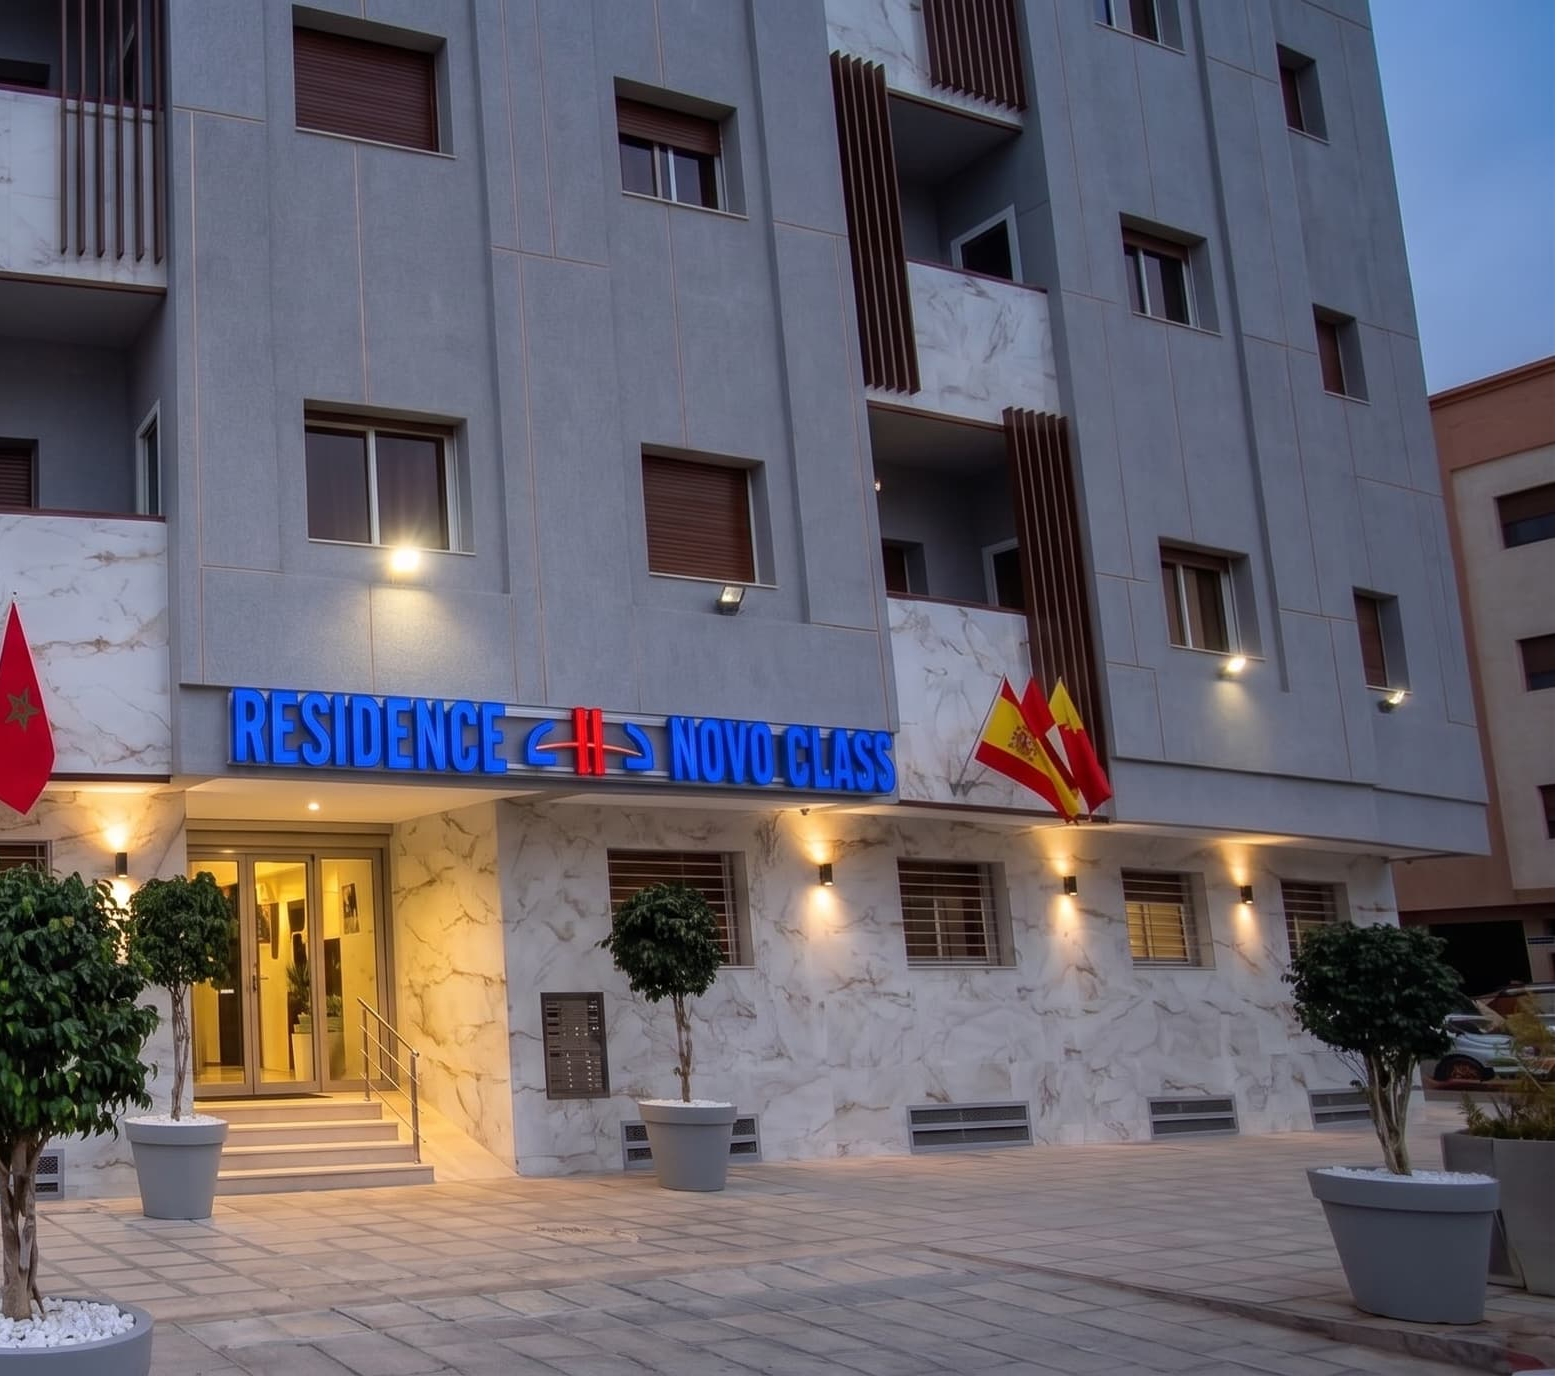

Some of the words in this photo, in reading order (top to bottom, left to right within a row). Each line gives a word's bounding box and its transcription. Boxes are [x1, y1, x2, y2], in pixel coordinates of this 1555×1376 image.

[229, 686, 508, 774] RESIDENCE
[666, 715, 775, 786] NOVO
[782, 724, 896, 794] CLASS
